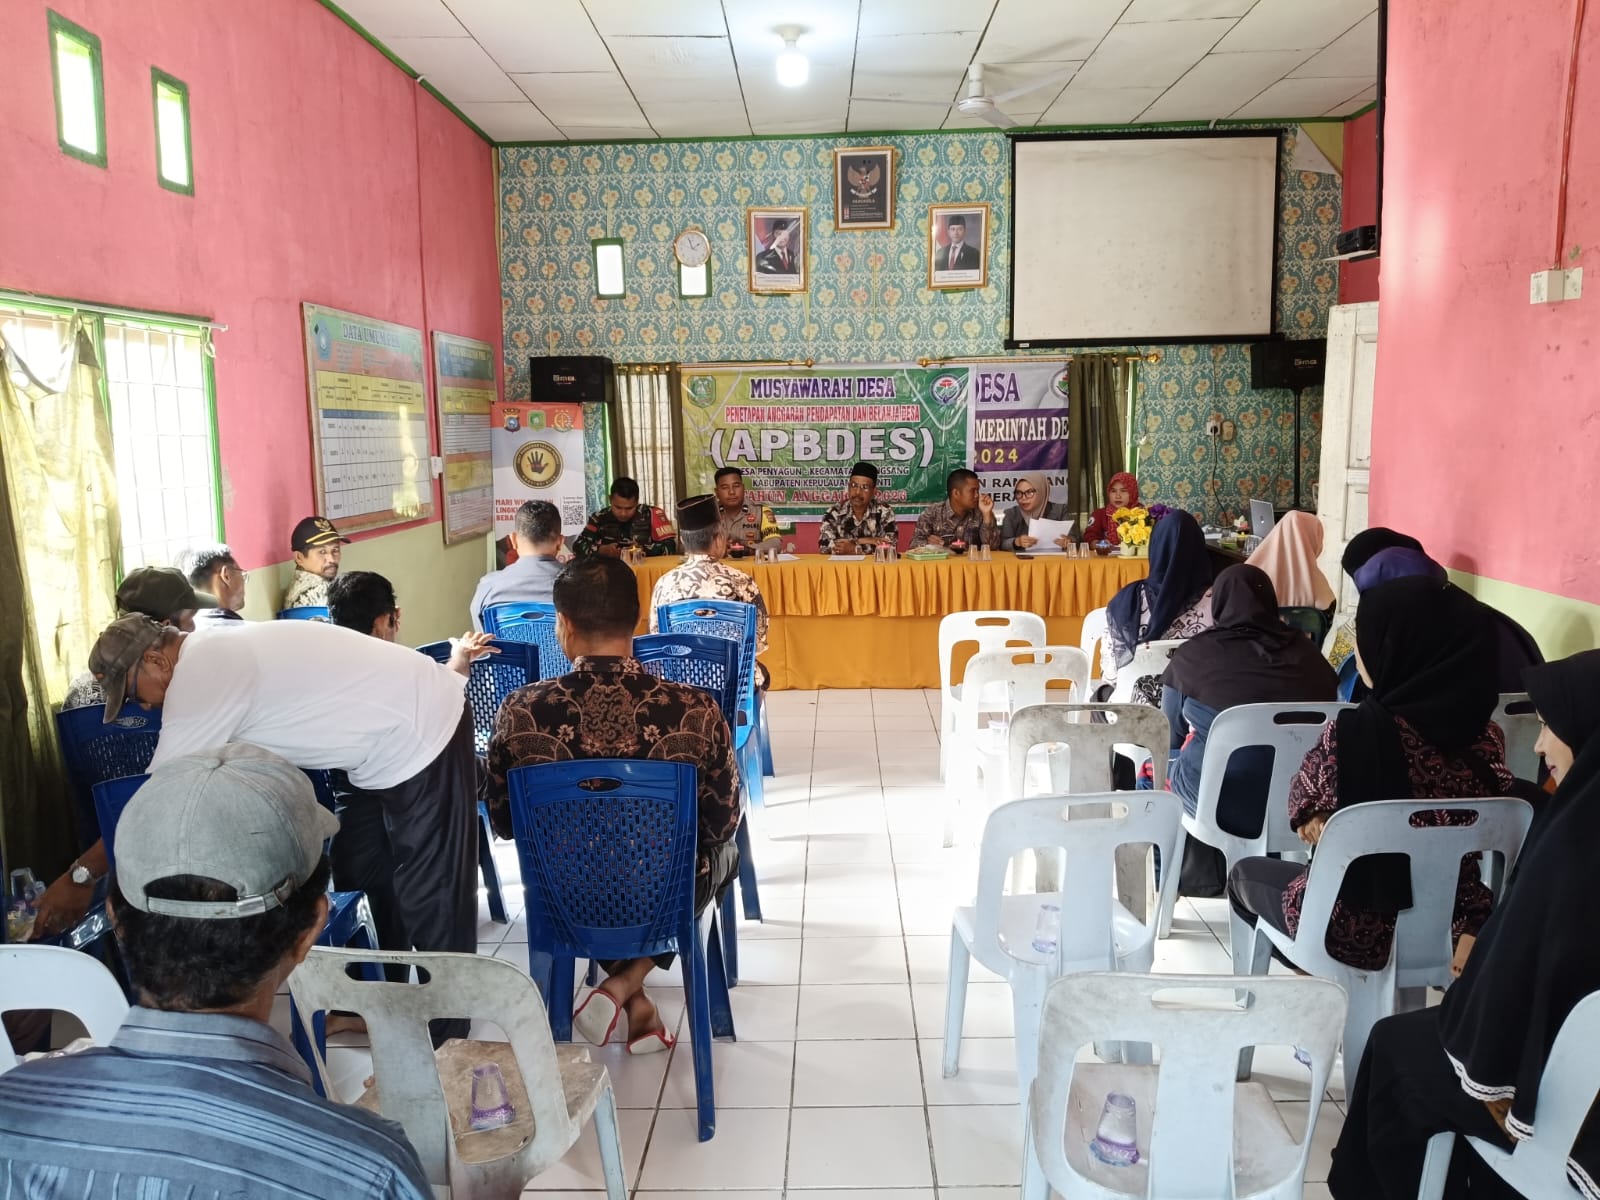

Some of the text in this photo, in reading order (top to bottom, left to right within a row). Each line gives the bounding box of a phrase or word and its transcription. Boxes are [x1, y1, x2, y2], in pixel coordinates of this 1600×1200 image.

[750, 377, 896, 399] MUSYAWARAH DESA
[726, 406, 765, 423] PENETAPAN
[852, 405, 867, 421] DAN
[901, 404, 920, 421] DESA
[710, 427, 935, 469] (APBDES)
[757, 467, 802, 476] PENYAGUN
[752, 479, 801, 487] KABUPATEN
